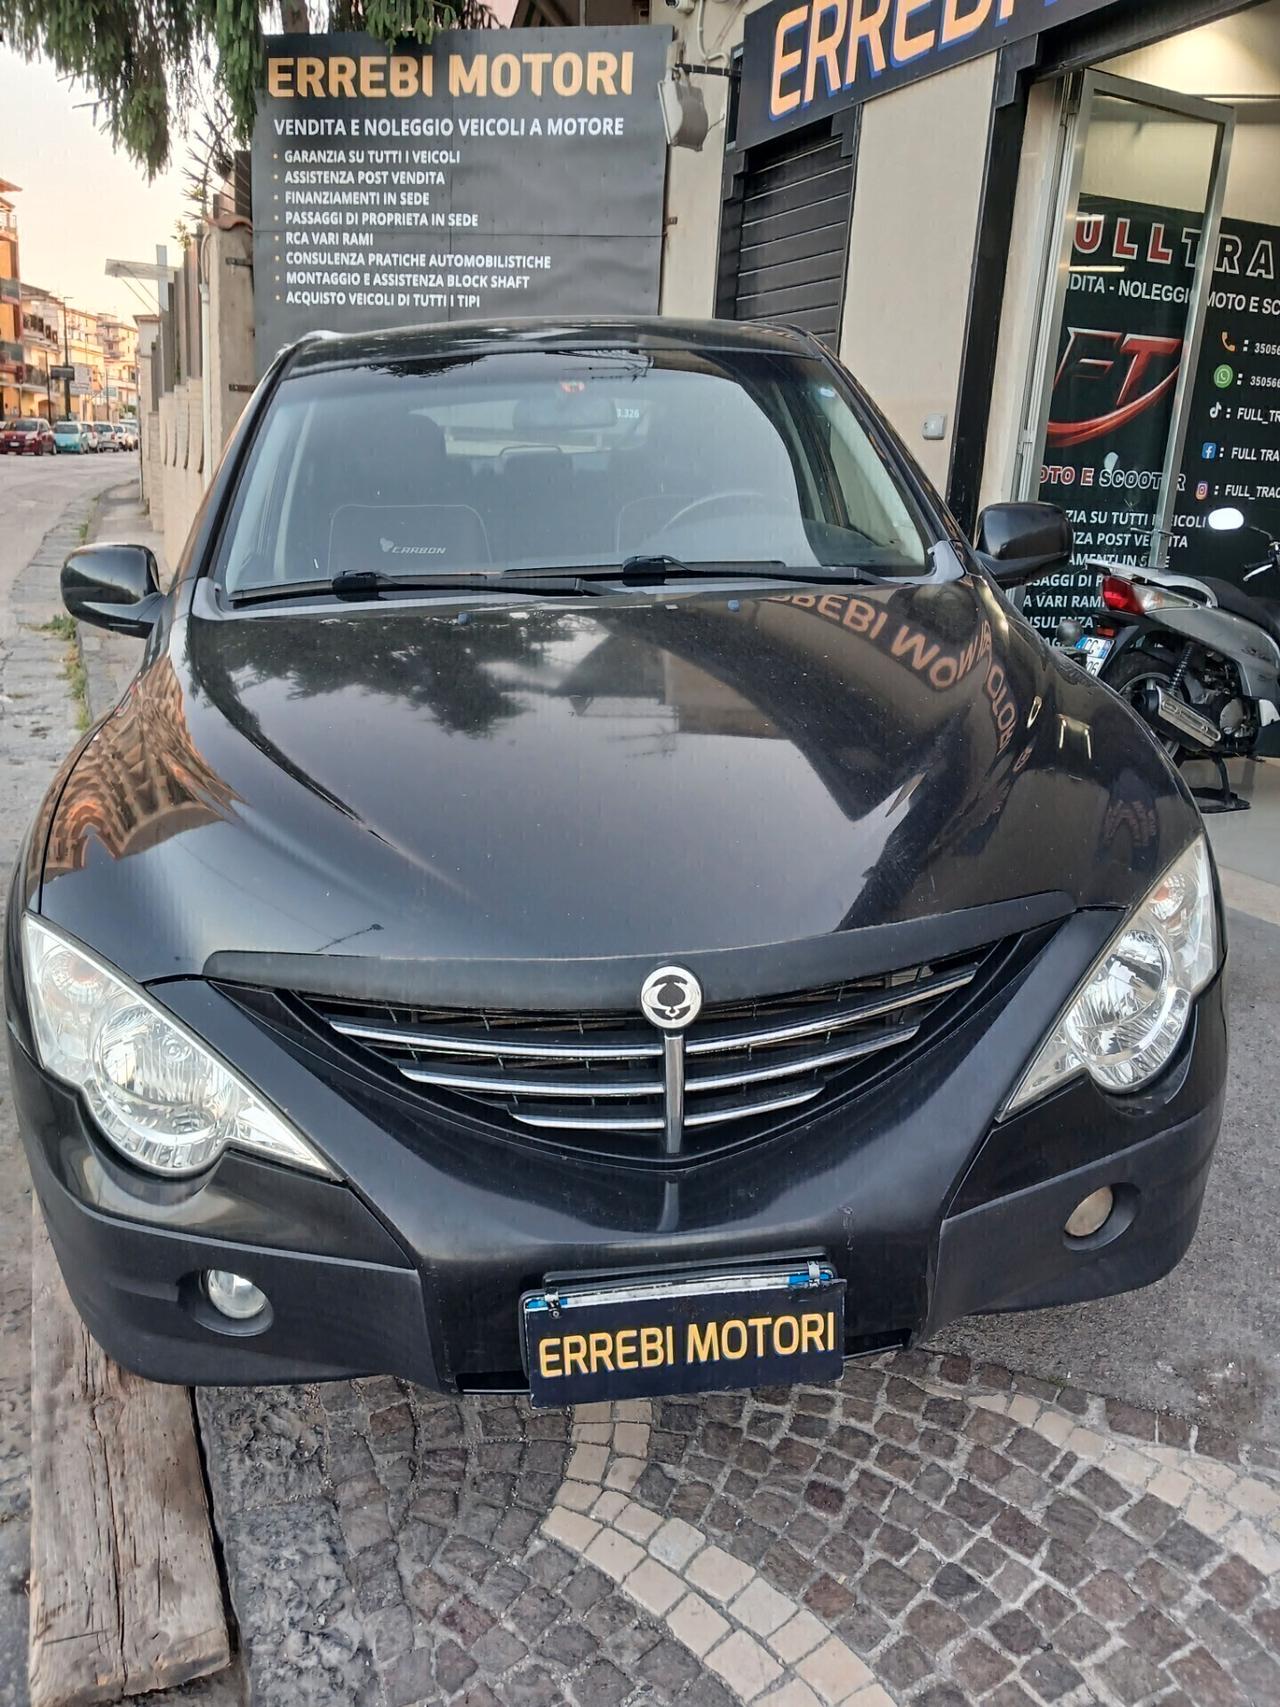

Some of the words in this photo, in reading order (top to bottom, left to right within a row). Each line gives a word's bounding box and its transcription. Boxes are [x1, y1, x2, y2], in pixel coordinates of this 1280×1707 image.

[268, 55, 433, 98] ERREBI
[448, 51, 634, 98] MOTORI
[273, 118, 347, 136] VENDITA
[351, 118, 360, 136] E
[364, 118, 454, 136] NOLEGGIO
[458, 118, 525, 136] VEICOLI
[529, 118, 542, 136] A
[547, 117, 624, 136] MOTORE
[284, 150, 345, 164] GARANZIA
[348, 150, 365, 164] SU
[368, 150, 402, 164] TUTTI
[405, 150, 409, 164] I
[411, 151, 460, 164] VEICOLI
[284, 170, 355, 185] ASSISTENZA
[358, 171, 388, 185] POST
[391, 171, 445, 185] VENDITA
[285, 191, 380, 205] FINANZIAMENTI
[383, 192, 397, 206] IN
[400, 192, 430, 206] SEDE
[285, 211, 343, 225] PASSAGGI
[346, 212, 359, 226] DI
[362, 212, 429, 227] PROPRIETA
[432, 213, 445, 227] IN
[448, 213, 479, 227] SEDE
[285, 231, 309, 245] RCA
[311, 232, 339, 245] VARI
[342, 232, 374, 246] RAMI
[286, 251, 366, 266] CONSULENZA
[368, 253, 426, 267] PRATICHE
[428, 254, 552, 269] AUTOMOBILISTICHE
[286, 271, 361, 285] MONTAGGIO
[363, 272, 371, 286] E
[373, 273, 445, 287] ASSISTENZA
[447, 274, 489, 288] BLOCK
[490, 275, 531, 289] SHAFT
[286, 290, 347, 307] ACQUISTO
[348, 292, 395, 306] VEICOLI
[397, 293, 410, 306] DI
[413, 293, 447, 307] TUTTI
[457, 294, 481, 308] TIPI
[1068, 273, 1106, 294] DITA
[1118, 279, 1192, 304] NOLEGGI
[1249, 296, 1260, 313] E
[1231, 446, 1257, 461] FULL
[1080, 467, 1095, 487] E
[1099, 469, 1187, 492] SCOOTR
[1089, 511, 1108, 525] SU
[1111, 512, 1149, 526] TUTTI
[1096, 532, 1130, 546] POST
[1133, 533, 1188, 548] VEITA
[1077, 574, 1093, 588] DI
[1036, 595, 1068, 608] VARI
[538, 1325, 675, 1379] ERREBI
[686, 1310, 836, 1364] MOTORI
